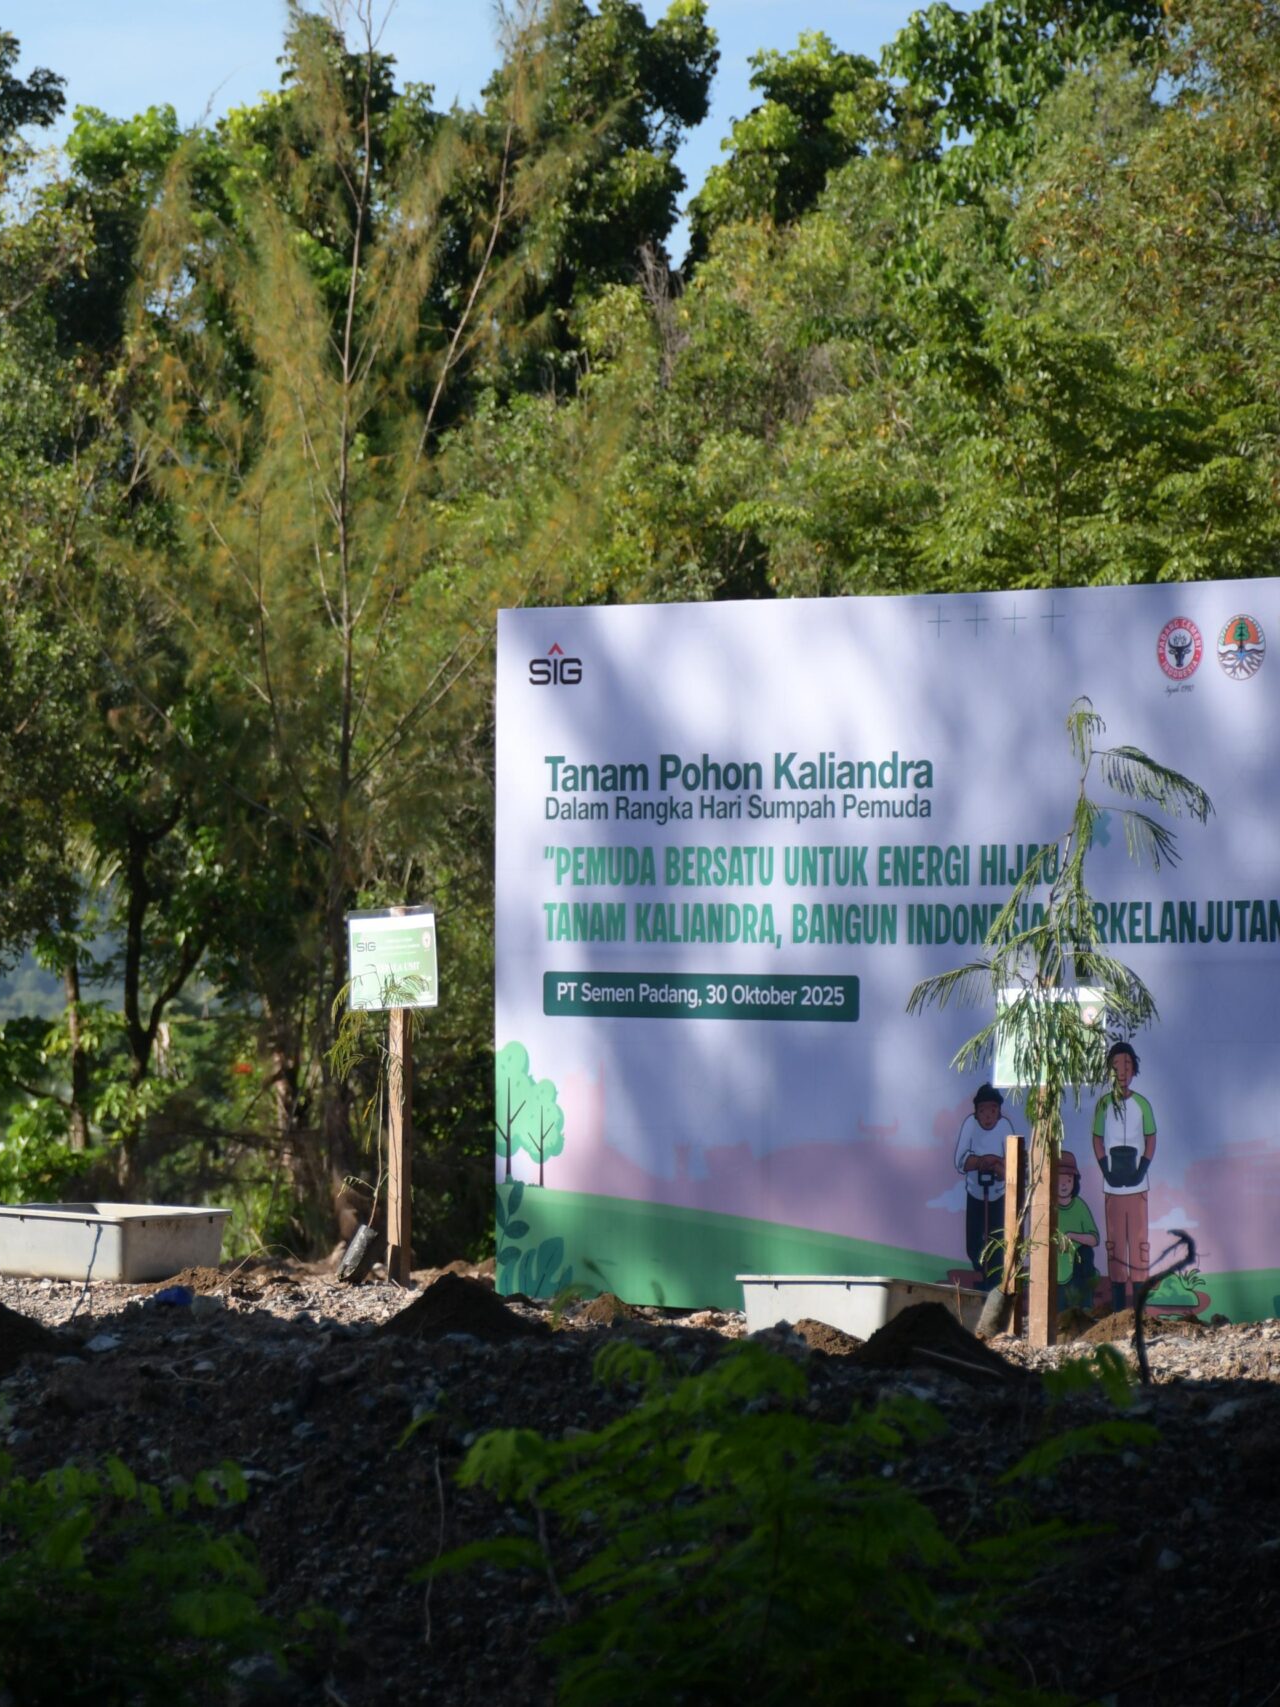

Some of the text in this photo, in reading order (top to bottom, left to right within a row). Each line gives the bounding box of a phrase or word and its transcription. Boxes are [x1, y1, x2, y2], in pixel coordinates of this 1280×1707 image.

[529, 658, 582, 685] SIG
[544, 751, 933, 792] Tanam Pohon Kaliandra
[545, 793, 932, 825] Dalam Rangka Hari Sumpah Pemuda
[665, 845, 774, 886] BERSATU
[784, 845, 869, 886] UNTUK
[878, 845, 970, 886] ENERGI
[543, 902, 626, 942] TANAM
[634, 902, 782, 949] KALIANDRA,
[792, 903, 898, 944] BANGUN
[357, 942, 377, 952] SIG
[557, 982, 845, 1008] PT Semen Padang, 30 Oktober 2025
